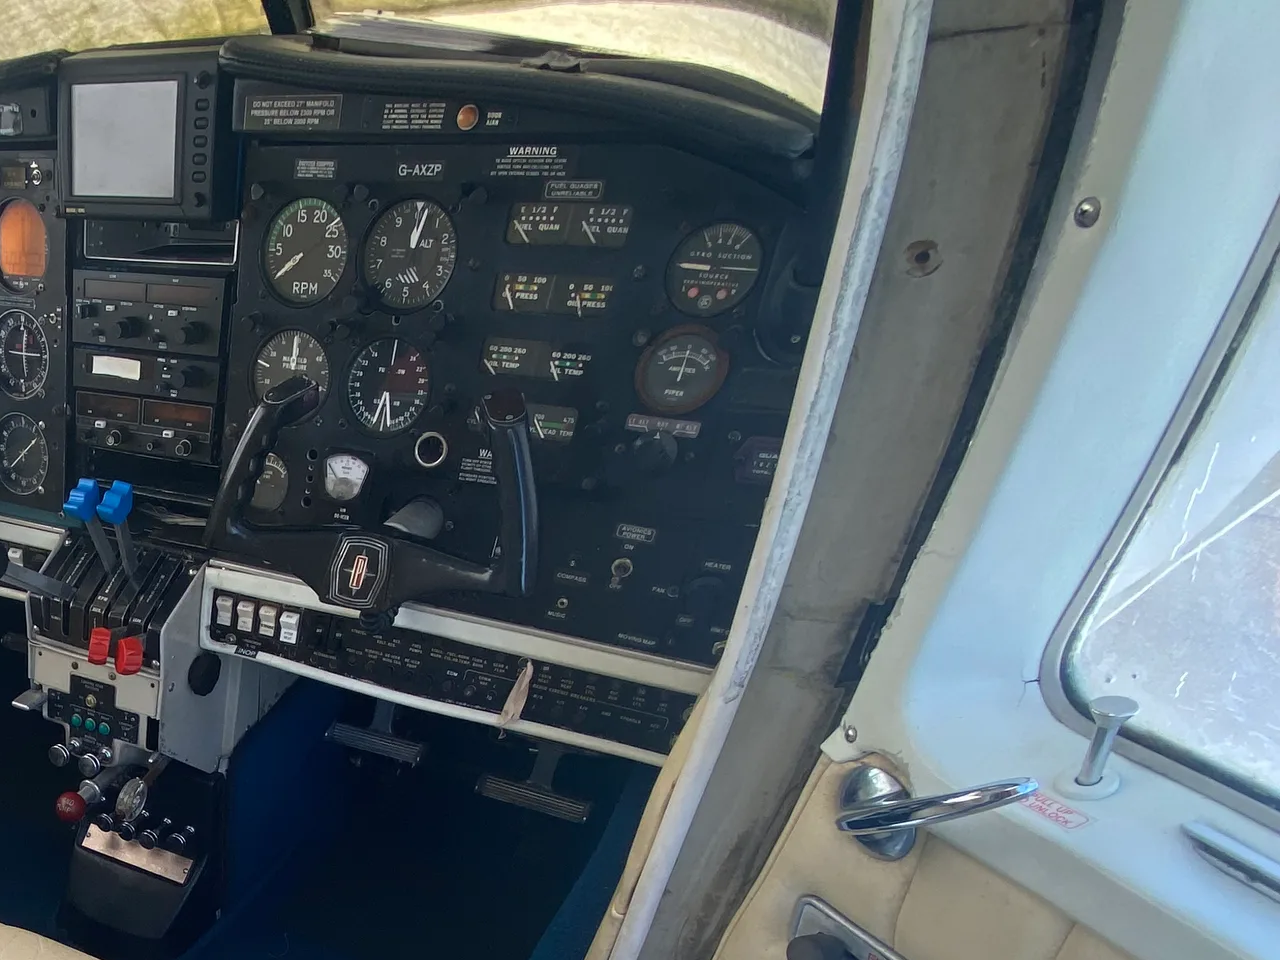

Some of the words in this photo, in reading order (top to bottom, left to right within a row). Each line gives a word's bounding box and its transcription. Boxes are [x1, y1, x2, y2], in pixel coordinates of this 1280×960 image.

[509, 146, 557, 156] WARNING
[398, 164, 442, 177] G-AXZP
[549, 183, 567, 191] FUEL
[550, 190, 594, 198] UNRELIABLE
[296, 209, 308, 224] 15
[313, 209, 328, 224] 20
[521, 206, 527, 214] E
[532, 206, 547, 214] 1/2
[553, 206, 560, 214] F
[589, 207, 595, 215] E
[601, 208, 617, 216] 1/2
[395, 216, 403, 228] 9
[282, 223, 294, 238] 10
[324, 224, 340, 239] 25
[538, 223, 561, 232] QUAN
[606, 226, 629, 234] QUAN
[380, 236, 388, 247] 8
[441, 233, 449, 245] 2
[419, 238, 435, 249] ALT
[275, 243, 283, 256] 5
[326, 244, 342, 259] 30
[690, 251, 713, 259] GYRO
[718, 252, 753, 261] SUCTION
[376, 258, 384, 270] 7
[436, 265, 444, 277] 3
[322, 269, 333, 278] 35
[699, 272, 729, 281] SOURCE
[517, 275, 528, 283] 50
[533, 276, 547, 284] 100
[291, 281, 319, 295] RPM
[385, 278, 392, 289] 6
[402, 286, 410, 298] 5
[422, 280, 429, 292] 4
[515, 292, 538, 300] PRESS
[582, 301, 606, 309] PRESS
[500, 345, 513, 353] 200
[513, 347, 527, 355] 260
[563, 352, 577, 360] 200
[578, 354, 592, 362] 260
[501, 361, 520, 369] TEMP
[564, 368, 584, 377] TEMP
[664, 388, 685, 397] PIPER
[559, 430, 574, 438] TEMP
[621, 525, 652, 536] AVIONICS
[622, 531, 646, 540] POWER
[705, 561, 732, 571] HEATER
[556, 571, 587, 583] COMPASS
[652, 586, 666, 594] FAN
[547, 610, 567, 619] MUSIC
[618, 632, 642, 644] MOVING
[642, 638, 657, 646] MAP
[237, 648, 257, 657] INOP
[1033, 791, 1054, 807] PULL
[1056, 806, 1074, 815] UP
[1028, 801, 1072, 826] UNLOCK
